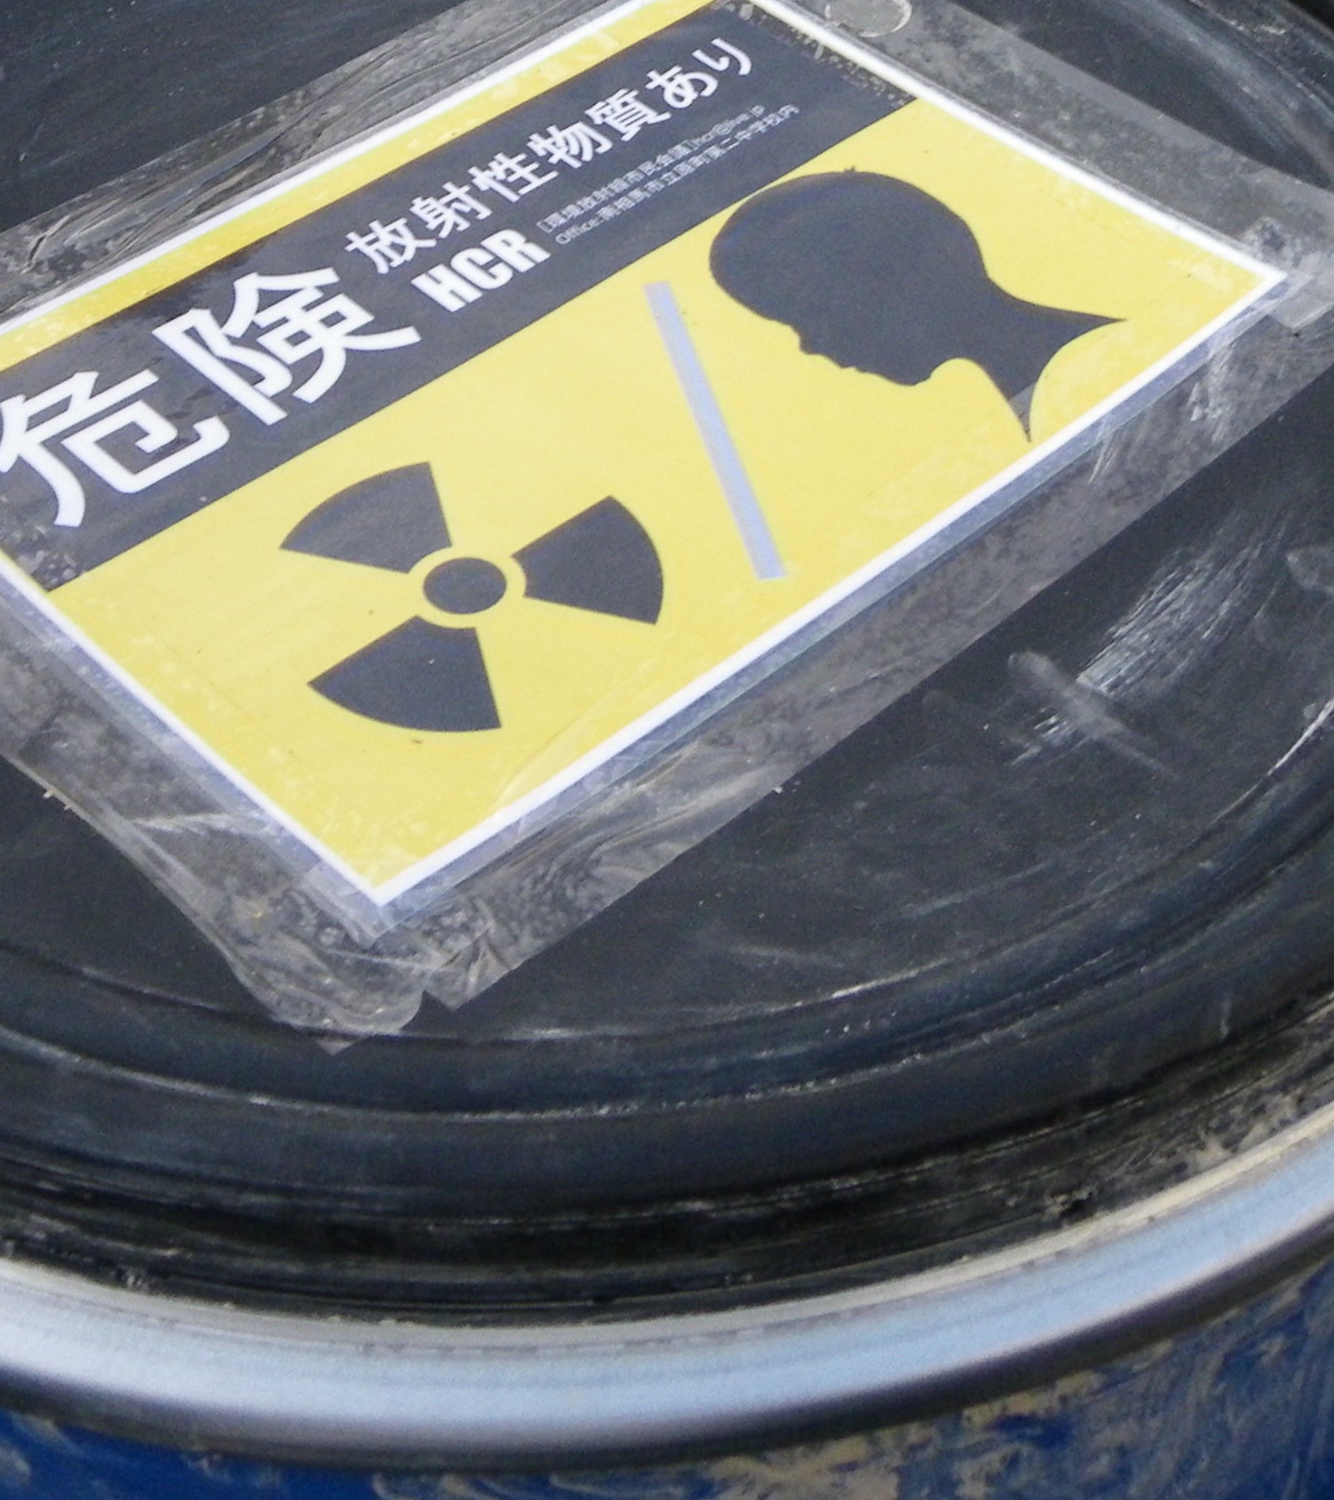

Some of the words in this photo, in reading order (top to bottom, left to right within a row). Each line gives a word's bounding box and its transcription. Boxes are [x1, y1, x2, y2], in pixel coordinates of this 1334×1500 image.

[344, 37, 753, 275] 放射性物質あり
[409, 228, 551, 312] HCR
